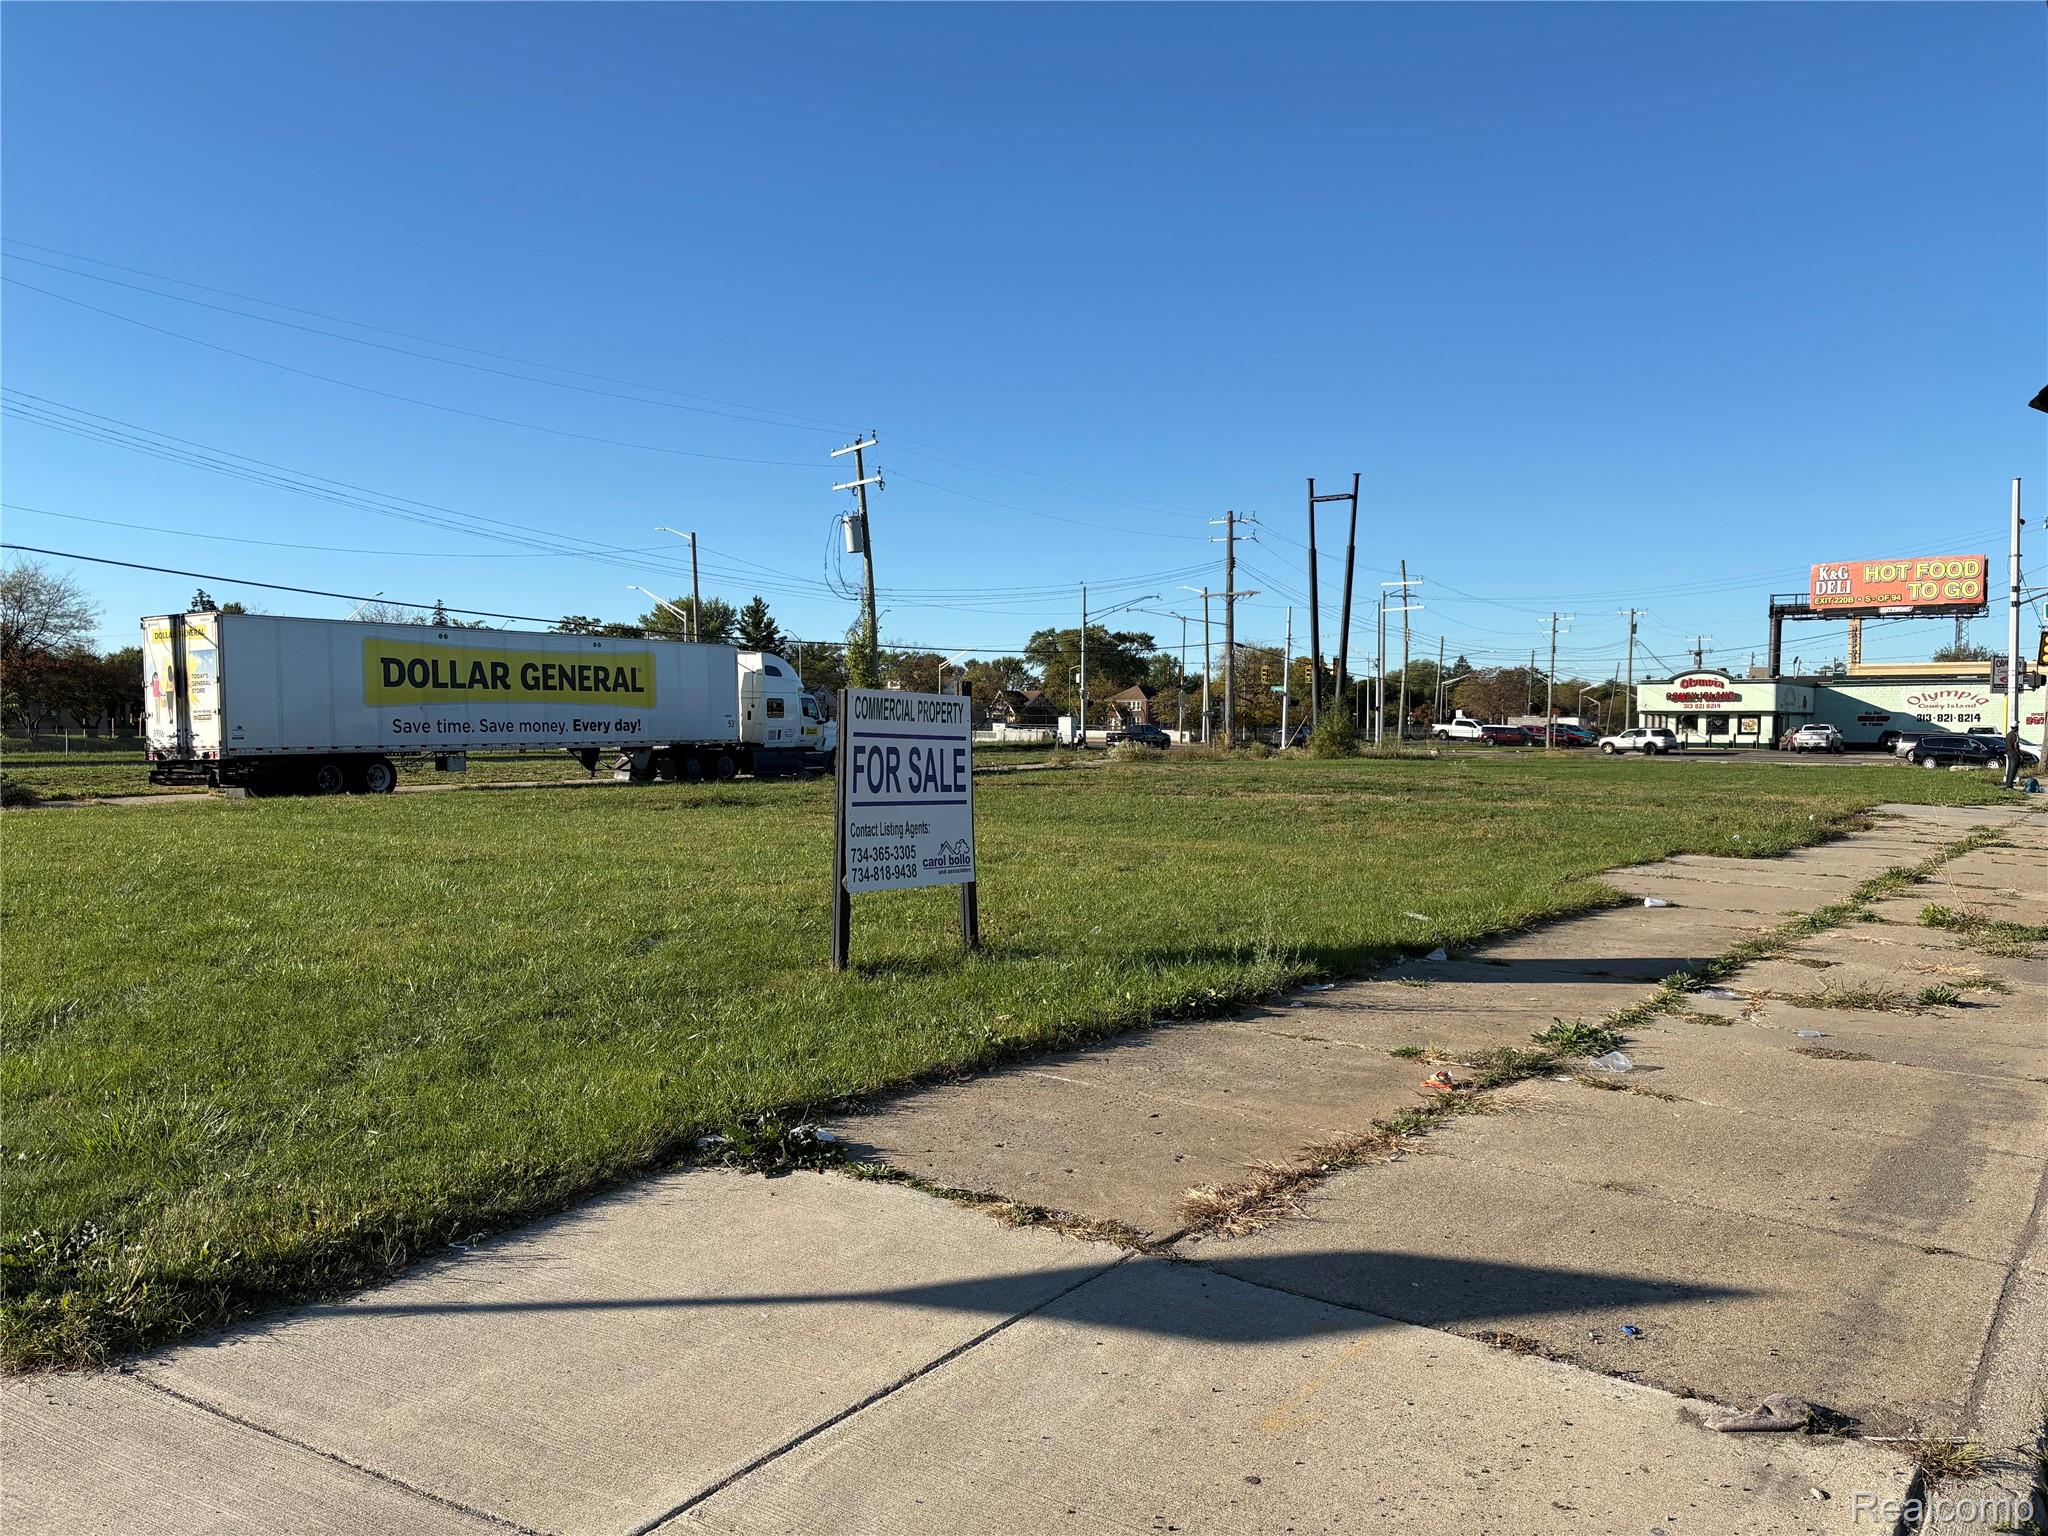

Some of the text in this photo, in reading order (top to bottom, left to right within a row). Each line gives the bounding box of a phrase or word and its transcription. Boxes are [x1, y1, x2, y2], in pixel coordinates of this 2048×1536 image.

[1819, 566, 1848, 581] K&G
[1864, 560, 1981, 583] HOT FOOD
[1815, 580, 1851, 595] DELI
[1907, 580, 1980, 600] TO GO
[1814, 597, 1834, 605] EXIT
[1891, 594, 1902, 602] 94
[380, 657, 645, 693] DOLLAR GENERAL
[1907, 690, 1990, 706] Olympia
[854, 696, 964, 724] COMMERCIAL PROPERTY
[392, 718, 641, 735] Save time. Save money. Every day!
[852, 745, 967, 794] FOR SALE
[850, 820, 931, 839] Contact Listing Agents:
[851, 844, 917, 863] 734-365-3305
[922, 855, 946, 867] carol
[851, 863, 918, 883] 734-818-9438
